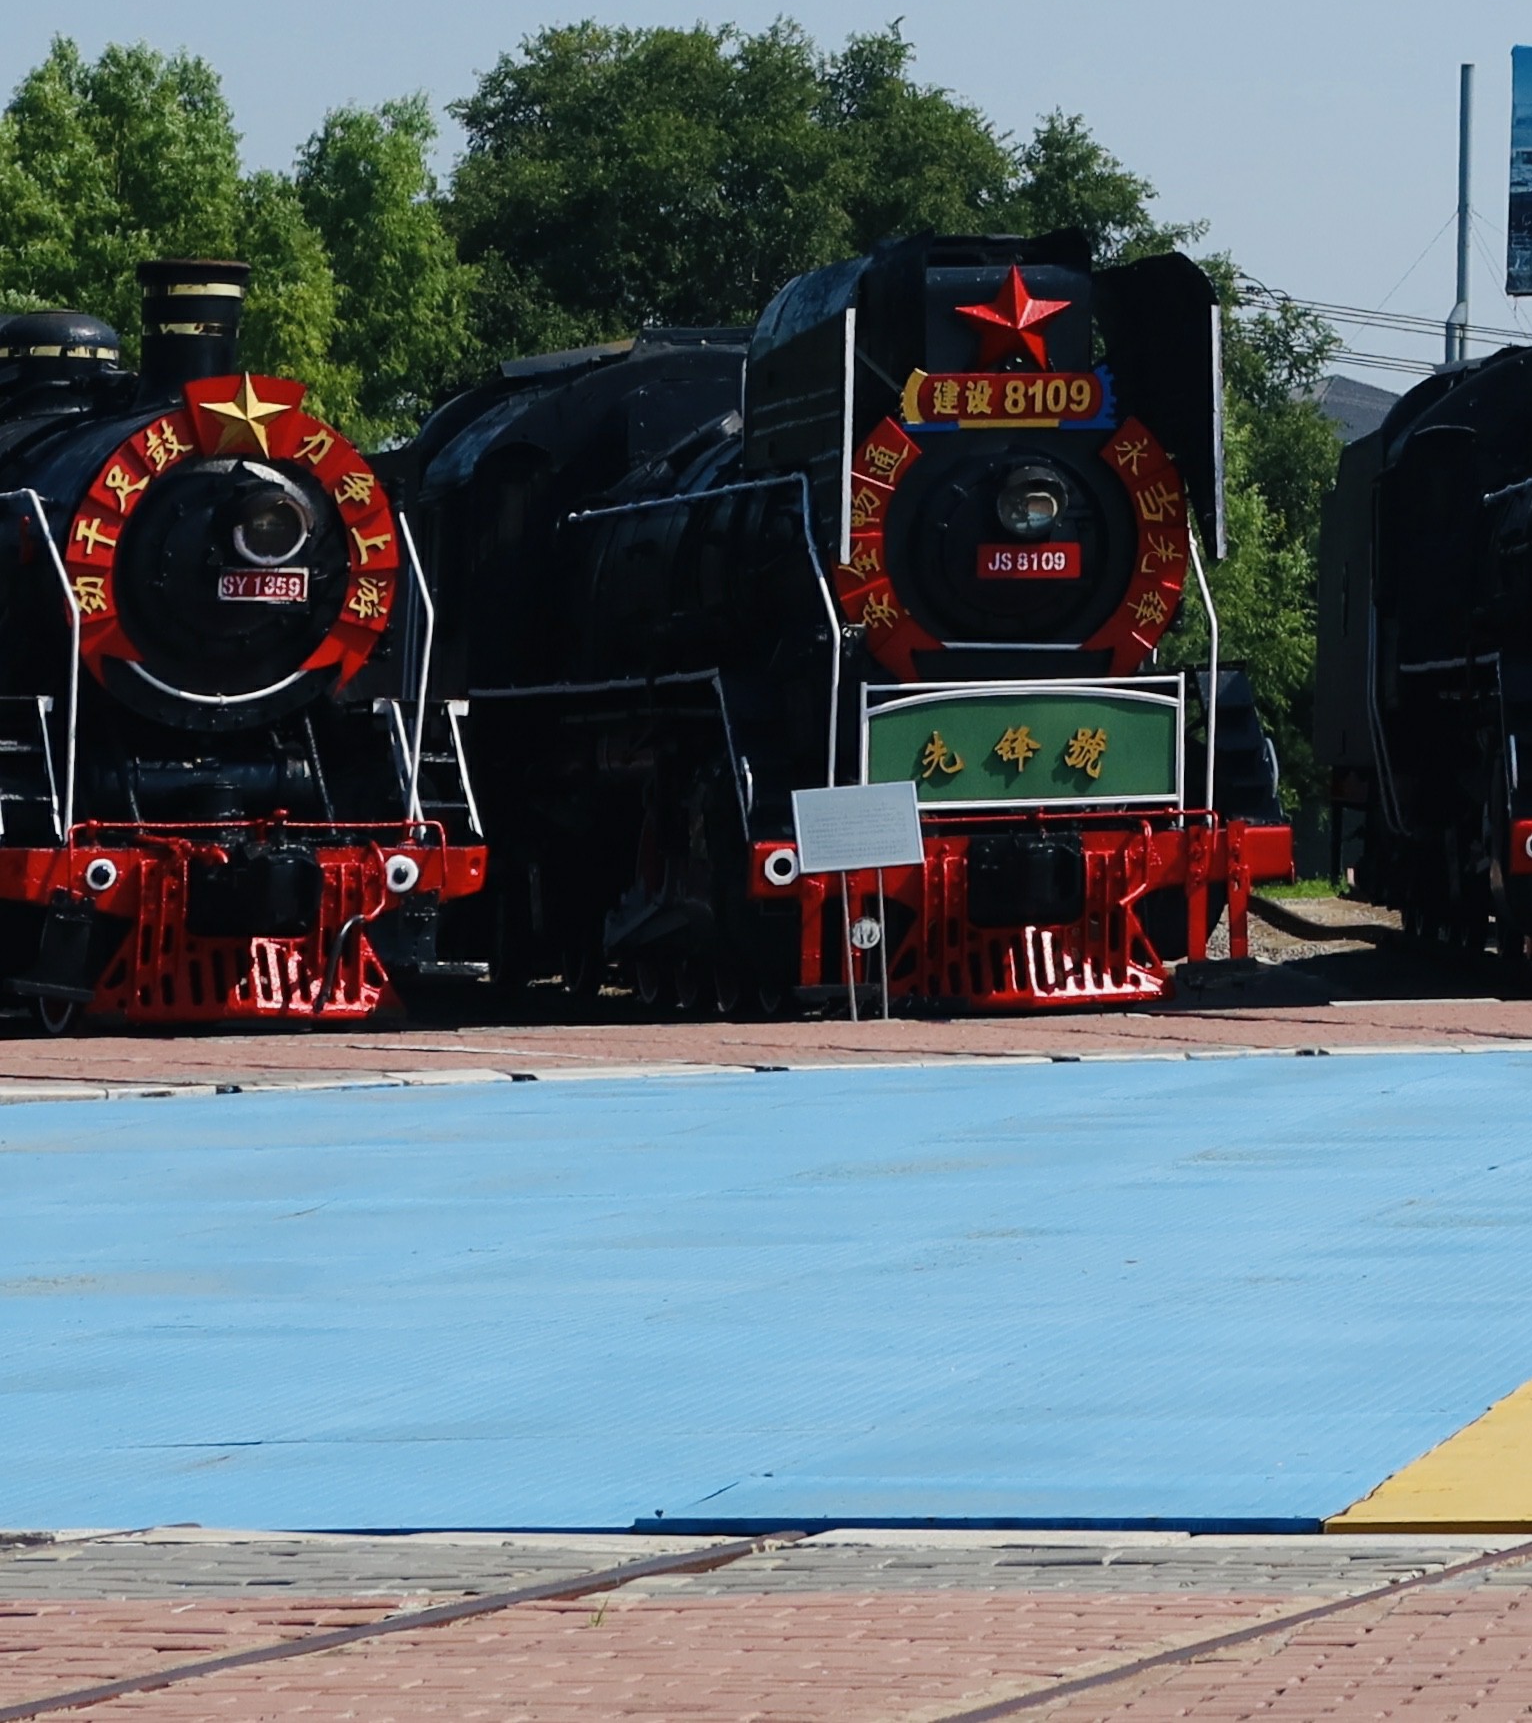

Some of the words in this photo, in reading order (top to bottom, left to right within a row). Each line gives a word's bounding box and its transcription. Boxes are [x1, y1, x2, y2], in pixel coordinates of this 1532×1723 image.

[933, 381, 992, 414] 建设
[1005, 380, 1091, 414] 8109
[75, 420, 194, 615] 鼓足干劲
[293, 429, 391, 618] 力争上游
[988, 552, 1012, 571] JS
[1017, 552, 1066, 571] 8109
[1115, 437, 1183, 627] 永当先锋
[222, 577, 246, 596] SY
[255, 577, 300, 596] 1359
